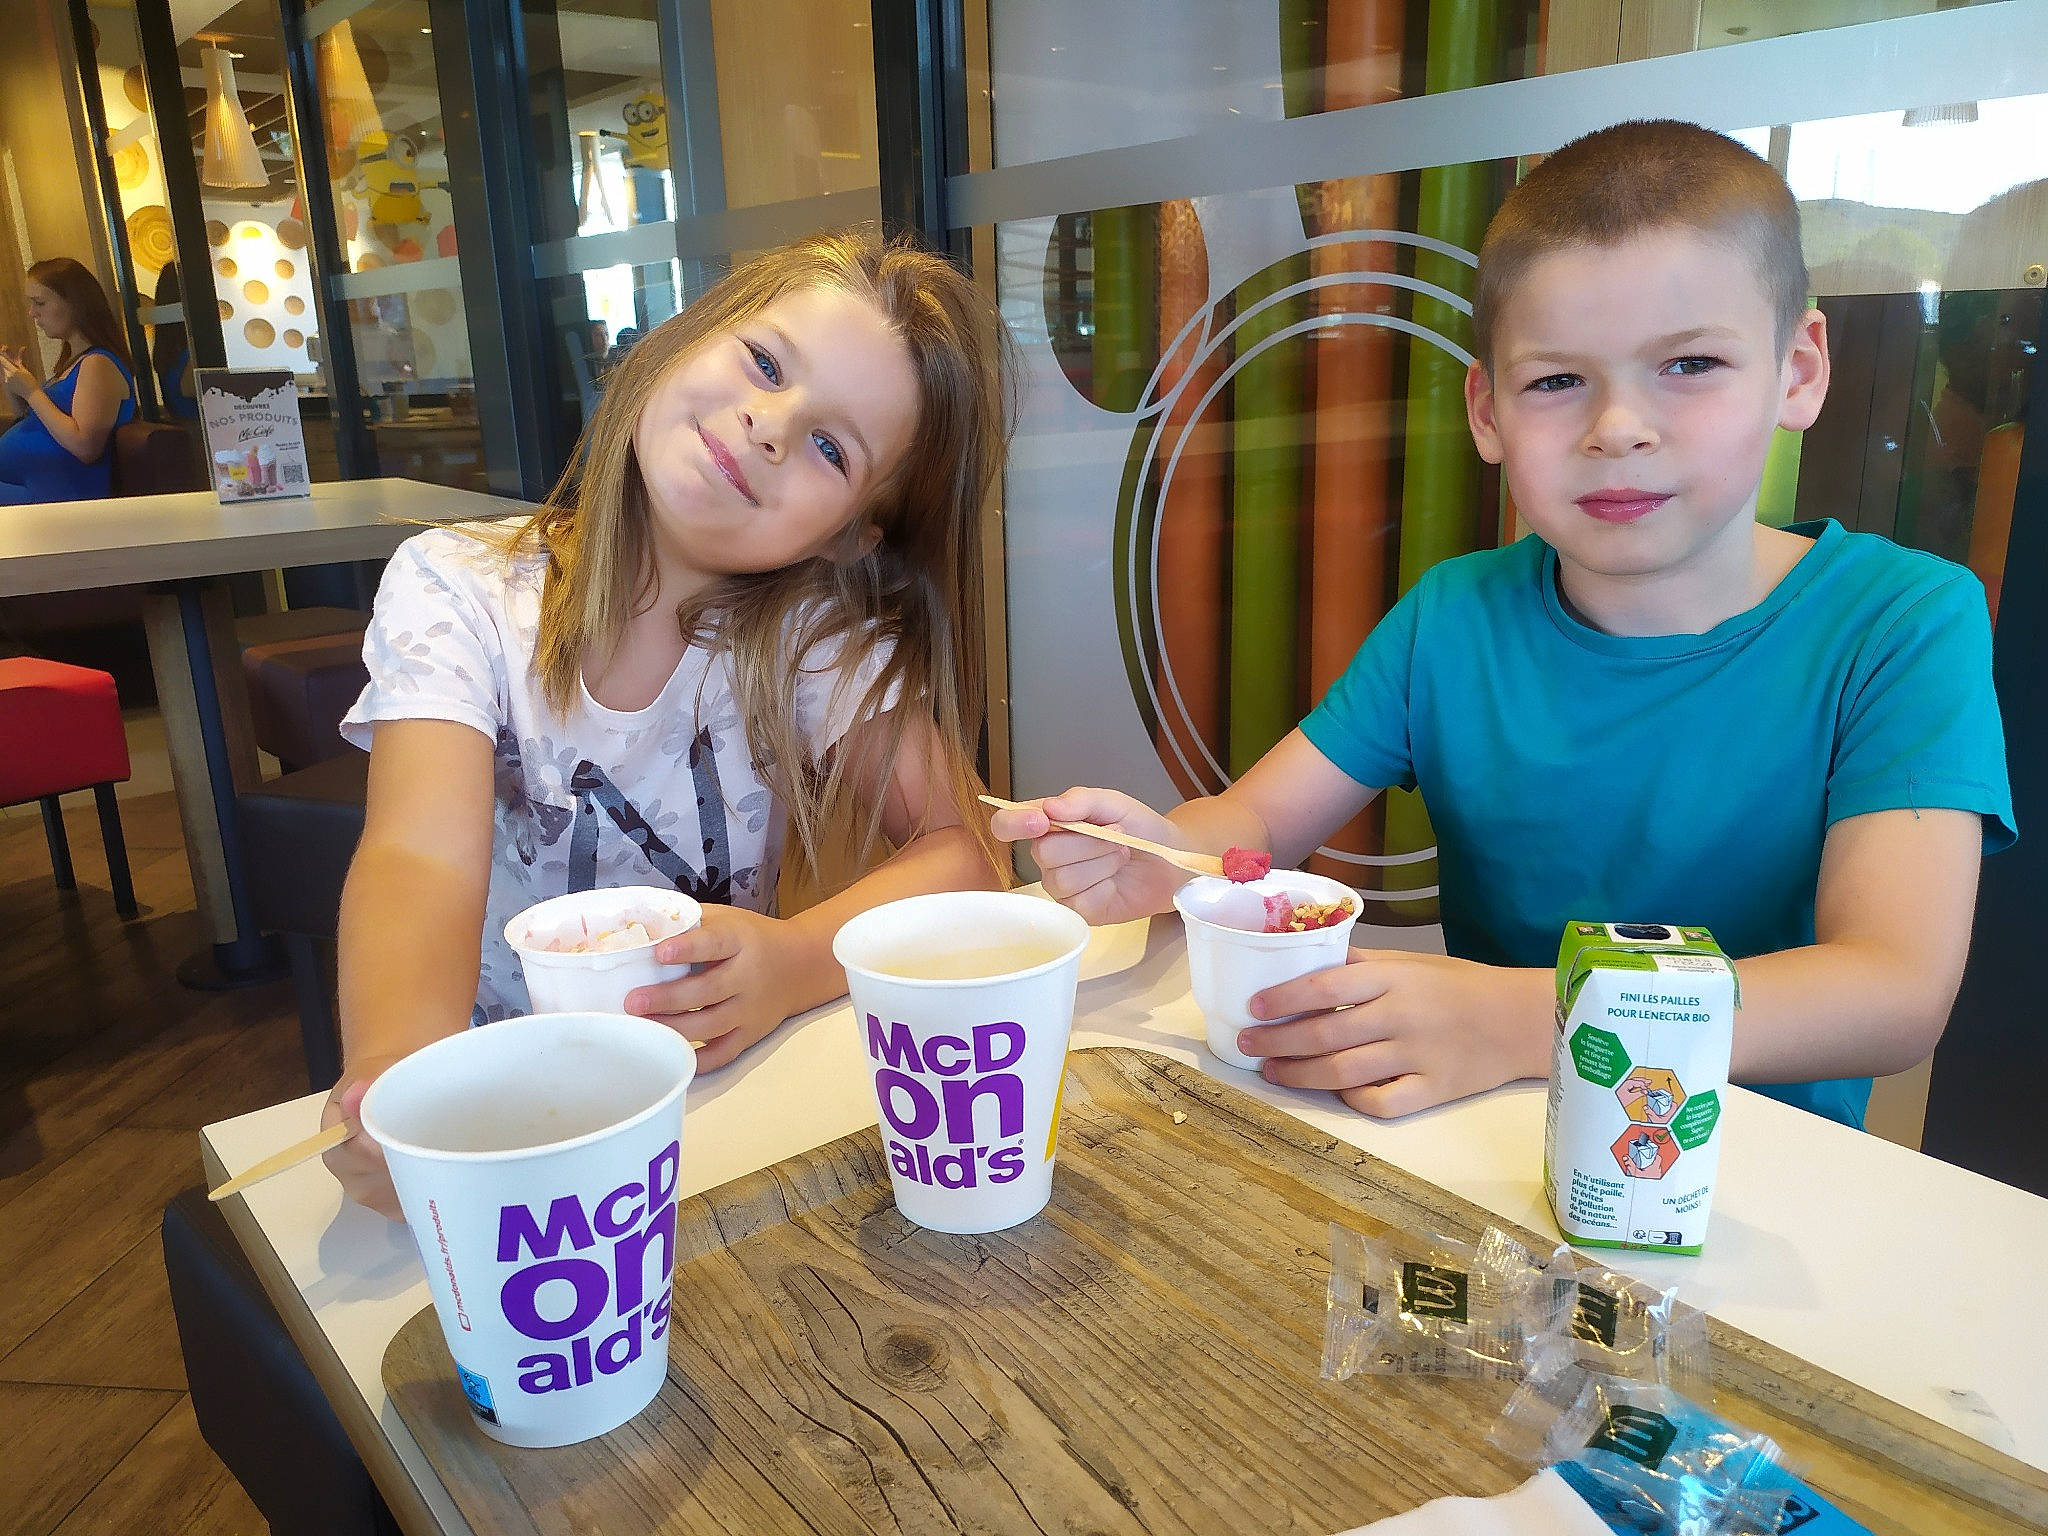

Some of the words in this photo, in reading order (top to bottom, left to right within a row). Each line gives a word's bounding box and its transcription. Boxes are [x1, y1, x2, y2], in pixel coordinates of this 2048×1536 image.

[208, 415, 236, 428] NOS
[239, 412, 299, 426] PRODUITS
[1620, 992, 1640, 1003] FINI
[1643, 994, 1658, 1004] LES
[1660, 995, 1700, 1006] PAILLES
[1607, 1007, 1637, 1018] POUR
[1692, 1013, 1710, 1022] BIO
[866, 1012, 1026, 1077] McD
[875, 1067, 1025, 1144] on
[889, 1138, 1025, 1190] ald's
[1572, 1178, 1587, 1189] plus
[1588, 1184, 1598, 1192] de
[1600, 1188, 1625, 1198] paille,
[1573, 1168, 1582, 1178] En
[1583, 1174, 1625, 1189] n'utilisant
[1571, 1186, 1579, 1194] tu
[1580, 1189, 1604, 1202] évites
[1701, 1185, 1709, 1195] DE
[496, 1140, 680, 1262] McD
[1570, 1193, 1577, 1202] la
[1578, 1199, 1614, 1212] pollution
[1568, 1211, 1581, 1222] des
[1581, 1218, 1618, 1228] océans...
[1569, 1202, 1578, 1211] de
[1579, 1206, 1587, 1215] la
[1587, 1211, 1618, 1221] nature,
[429, 1199, 465, 1313] mcdonalds.fr/produits
[500, 1201, 677, 1341] on
